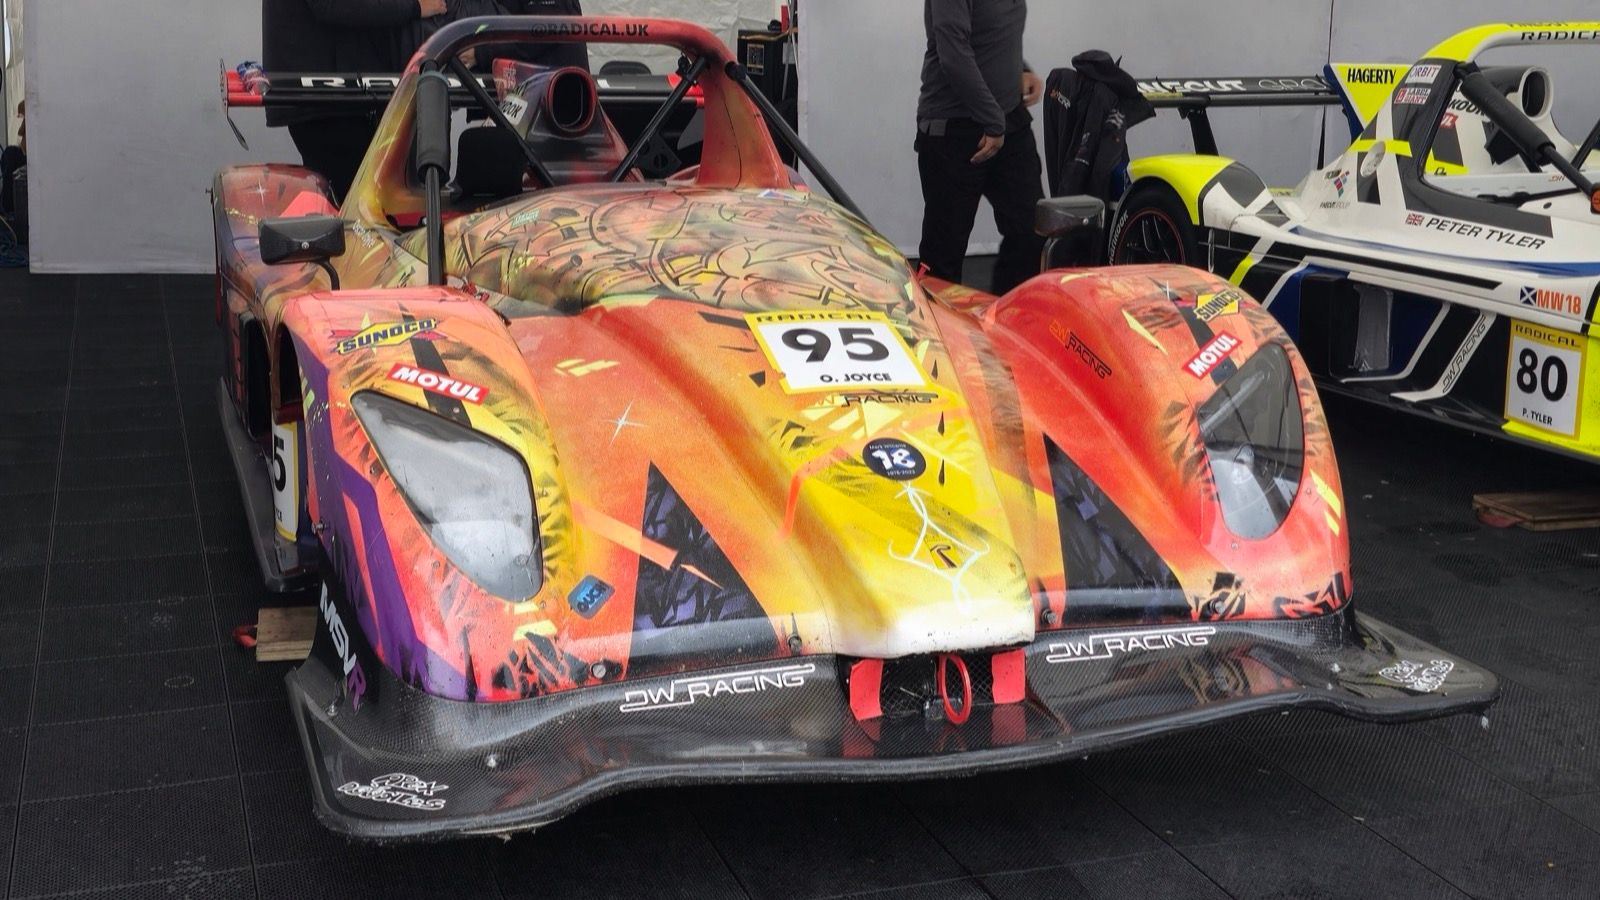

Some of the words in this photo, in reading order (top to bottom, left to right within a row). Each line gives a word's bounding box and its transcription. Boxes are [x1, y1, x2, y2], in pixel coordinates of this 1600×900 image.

[529, 22, 649, 37] @RADICAL.UK
[1347, 68, 1396, 85] HAGERTY
[1410, 66, 1441, 79] ORBIT
[1426, 217, 1484, 238] PETER
[1485, 229, 1546, 250] TYLER
[756, 312, 883, 323] RADICAL
[1199, 289, 1240, 321] SUNOCO
[342, 319, 434, 353] SUNOCO
[781, 328, 890, 363] 95
[1515, 325, 1582, 349] RADICAL
[1066, 331, 1112, 379] RACING
[1188, 334, 1239, 378] MOTUL
[391, 366, 482, 402] MOTUL
[820, 374, 839, 383] O.
[844, 373, 892, 382] JOYCE
[1517, 348, 1568, 402] 80
[1522, 408, 1529, 418] P.
[1530, 410, 1553, 426] TYLER
[273, 434, 287, 492] 5
[872, 448, 916, 470] 18
[1046, 636, 1098, 663] DW
[1096, 626, 1216, 657] RACING
[620, 682, 680, 712] DW
[678, 664, 815, 703] RACING
